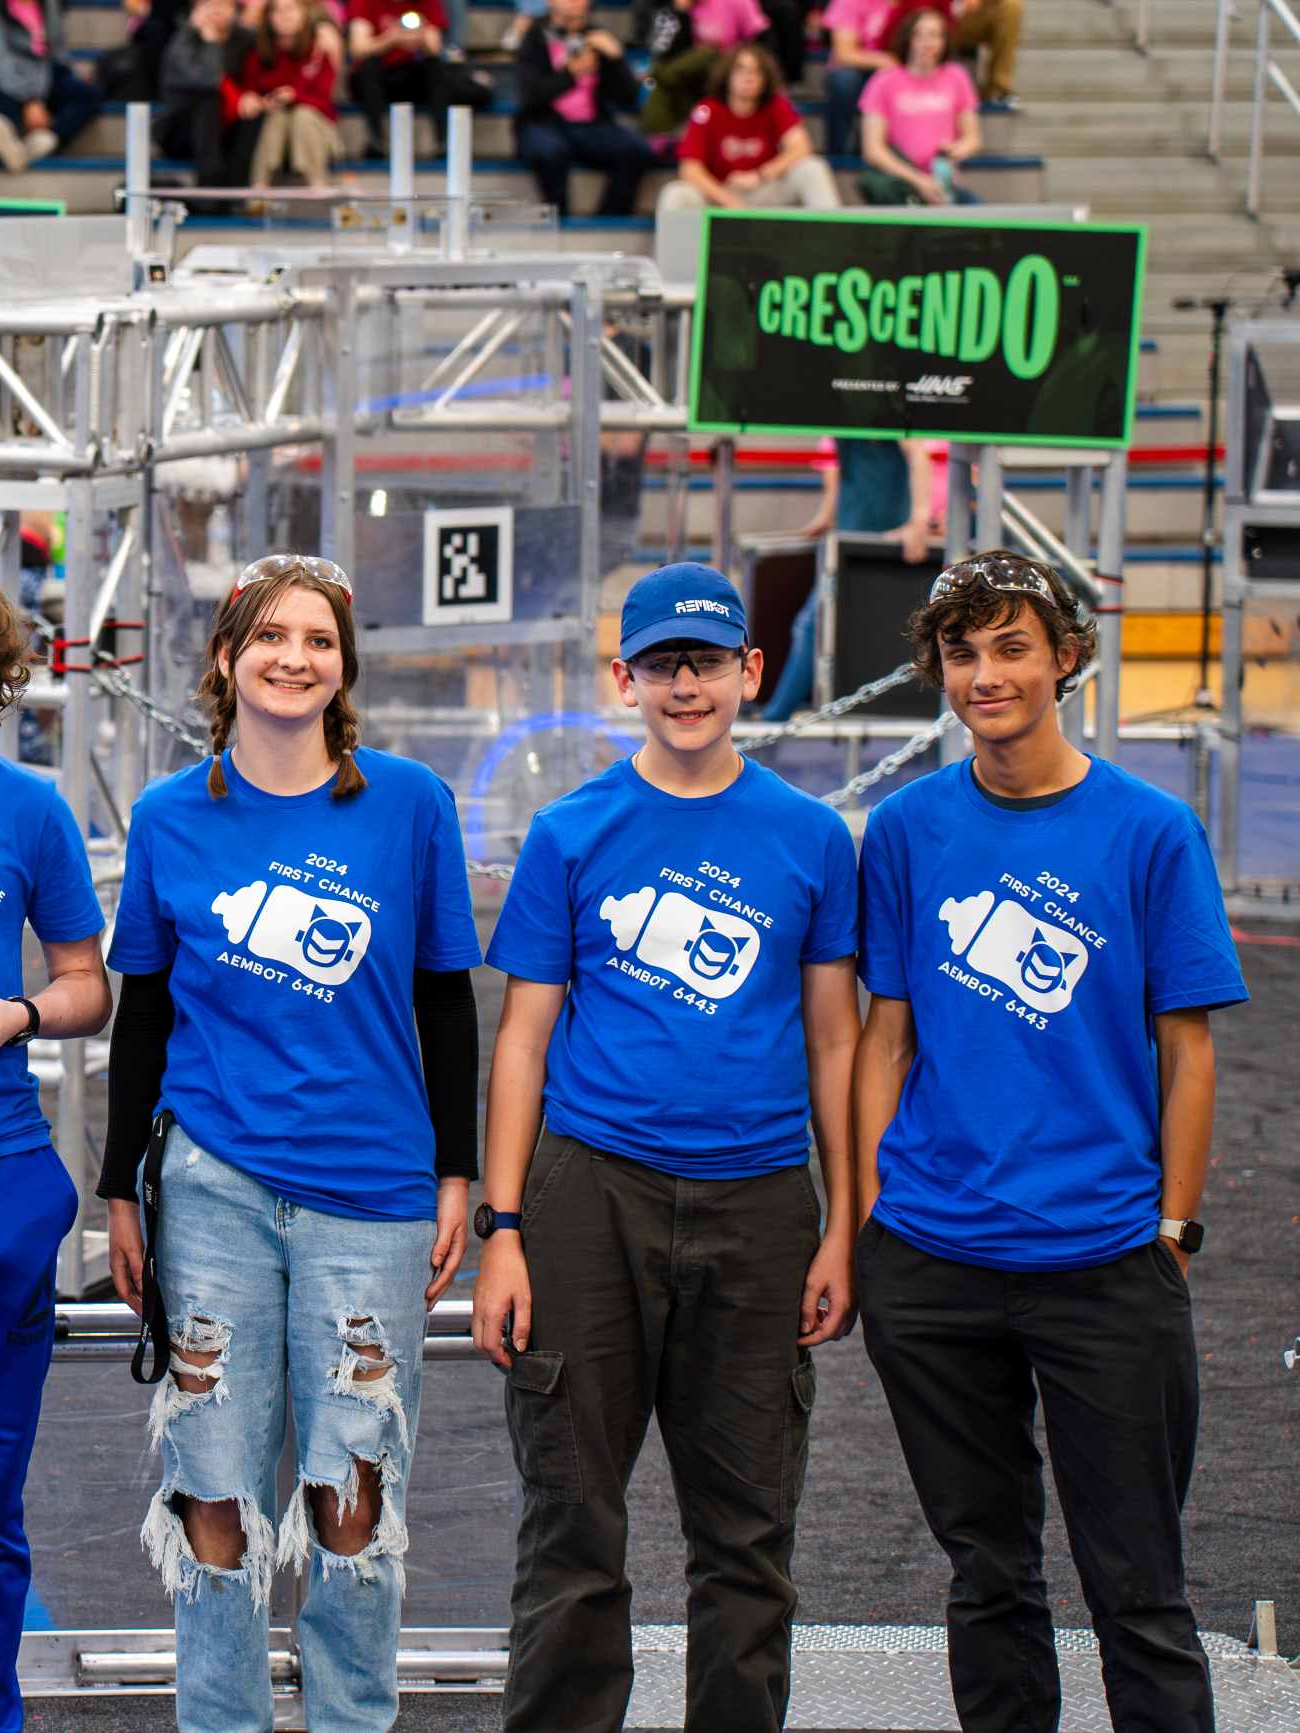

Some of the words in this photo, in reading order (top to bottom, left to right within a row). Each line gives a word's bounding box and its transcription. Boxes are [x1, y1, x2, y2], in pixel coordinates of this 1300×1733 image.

[758, 253, 1059, 379] CRESCENDO
[268, 861, 314, 883] FIRST
[318, 879, 381, 913] CHANCE
[305, 853, 348, 876] 2024
[698, 860, 742, 889] 2024
[1036, 871, 1081, 904] 2024
[659, 867, 706, 892] FIRST
[709, 889, 774, 929] CHANCE
[999, 873, 1042, 903] FIRST
[1043, 901, 1108, 949] CHANCE
[216, 951, 288, 984] AEMBOT
[291, 978, 336, 1003] 6443
[605, 956, 671, 990] AEMBOT
[672, 987, 720, 1015] 6443
[937, 961, 1004, 1002] AEMBOT
[1005, 999, 1049, 1030] 6443
